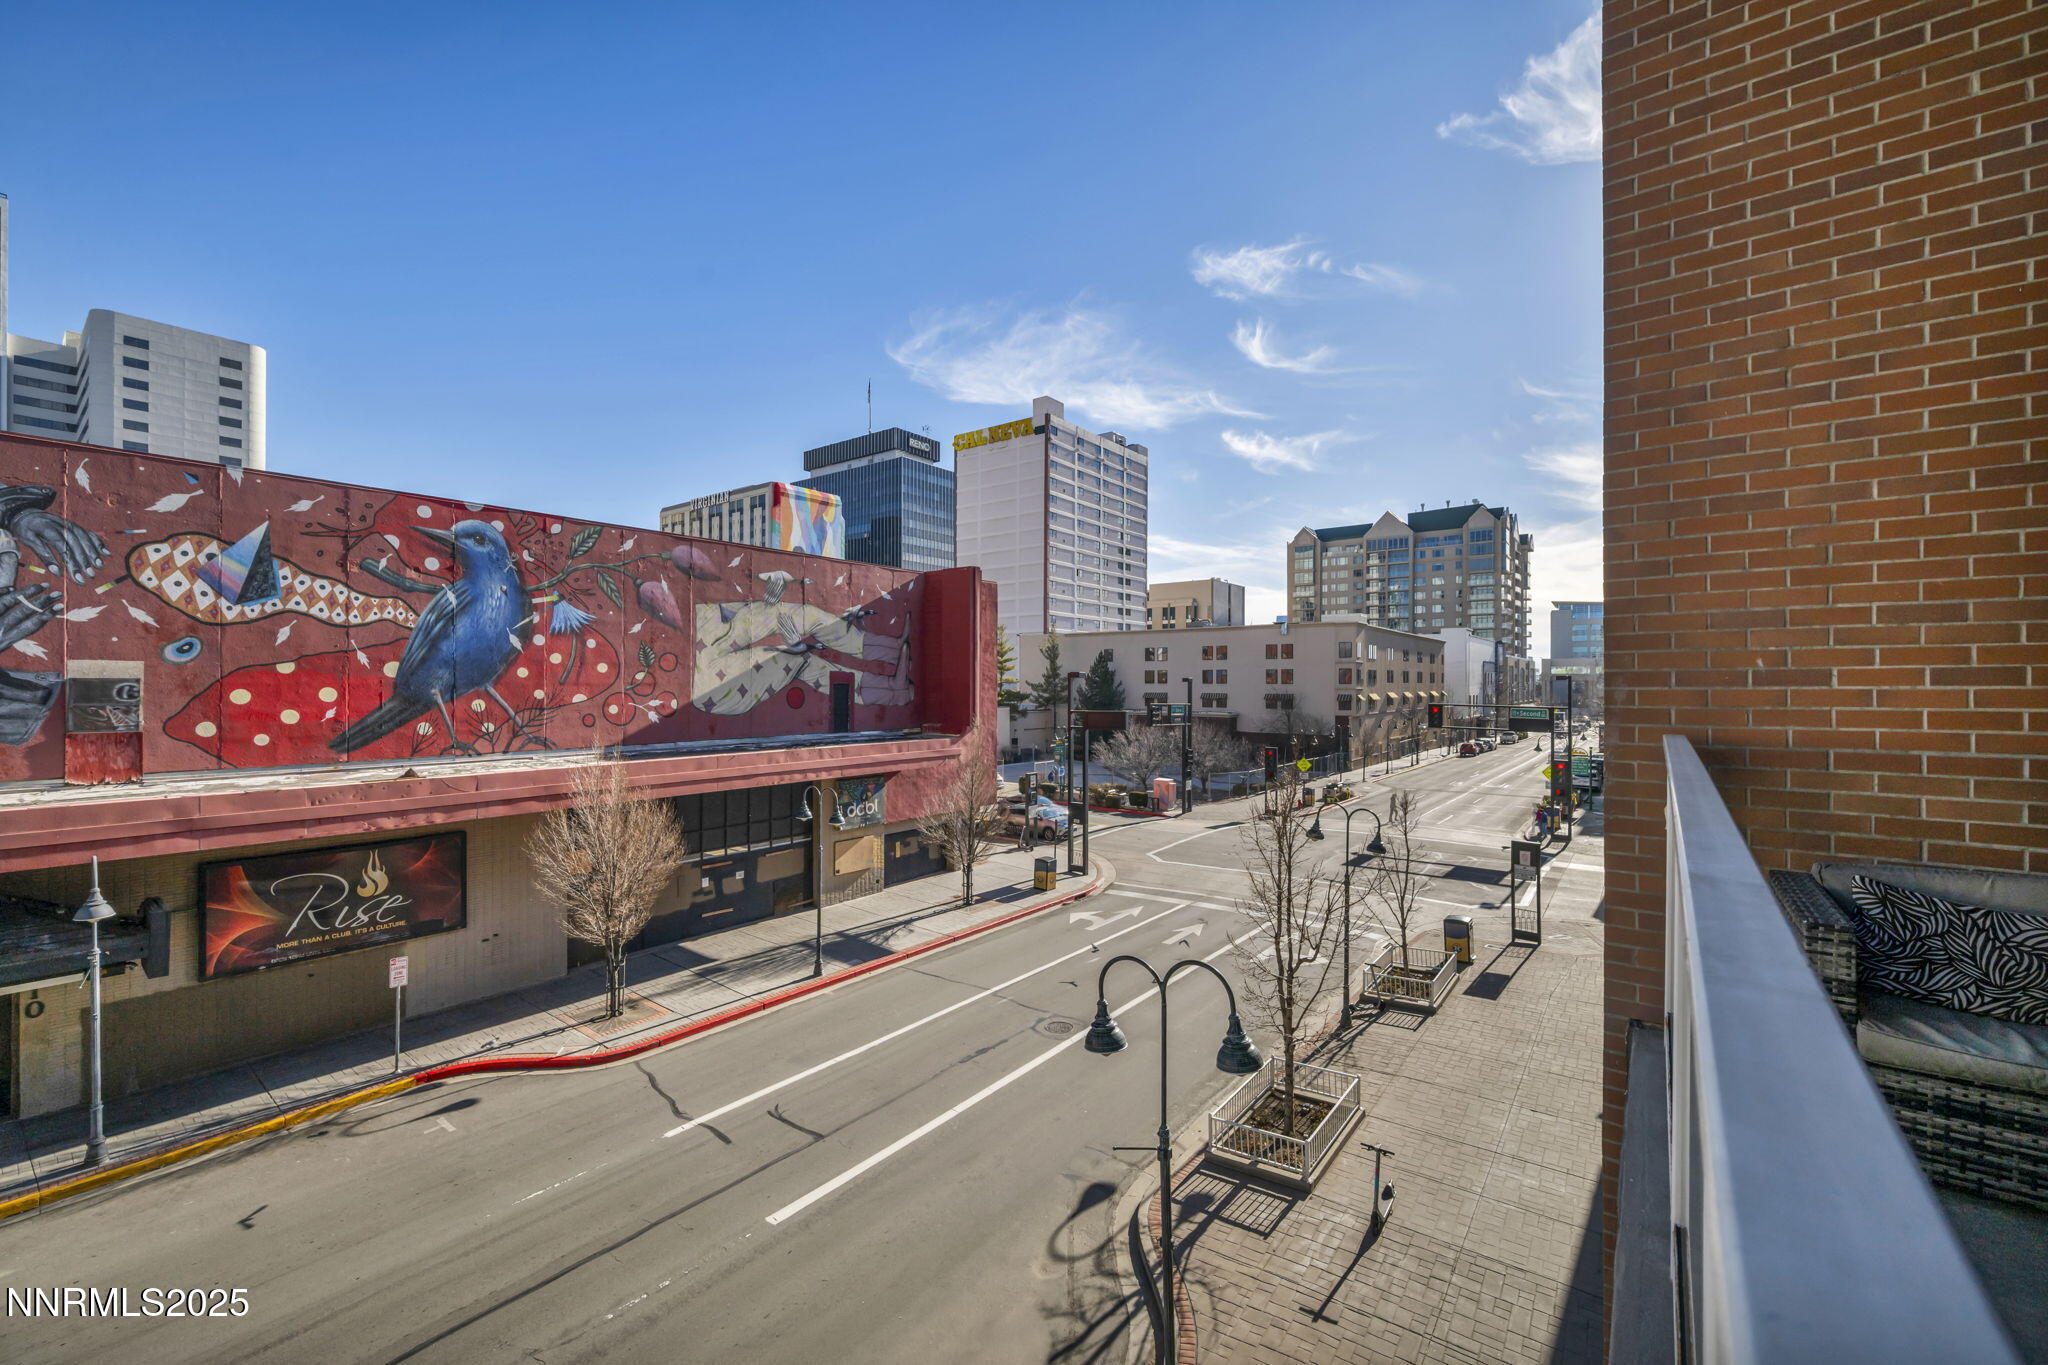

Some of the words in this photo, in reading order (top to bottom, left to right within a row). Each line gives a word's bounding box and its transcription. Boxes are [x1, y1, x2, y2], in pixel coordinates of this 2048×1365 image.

[909, 438, 930, 452] RENO
[953, 429, 988, 451] CAL
[988, 417, 1034, 444] NEVA
[690, 490, 729, 510] VIRGINIAN
[270, 873, 413, 937] Rise
[276, 940, 299, 950] MORE
[301, 936, 323, 945] THAN
[355, 927, 368, 935] IT'S
